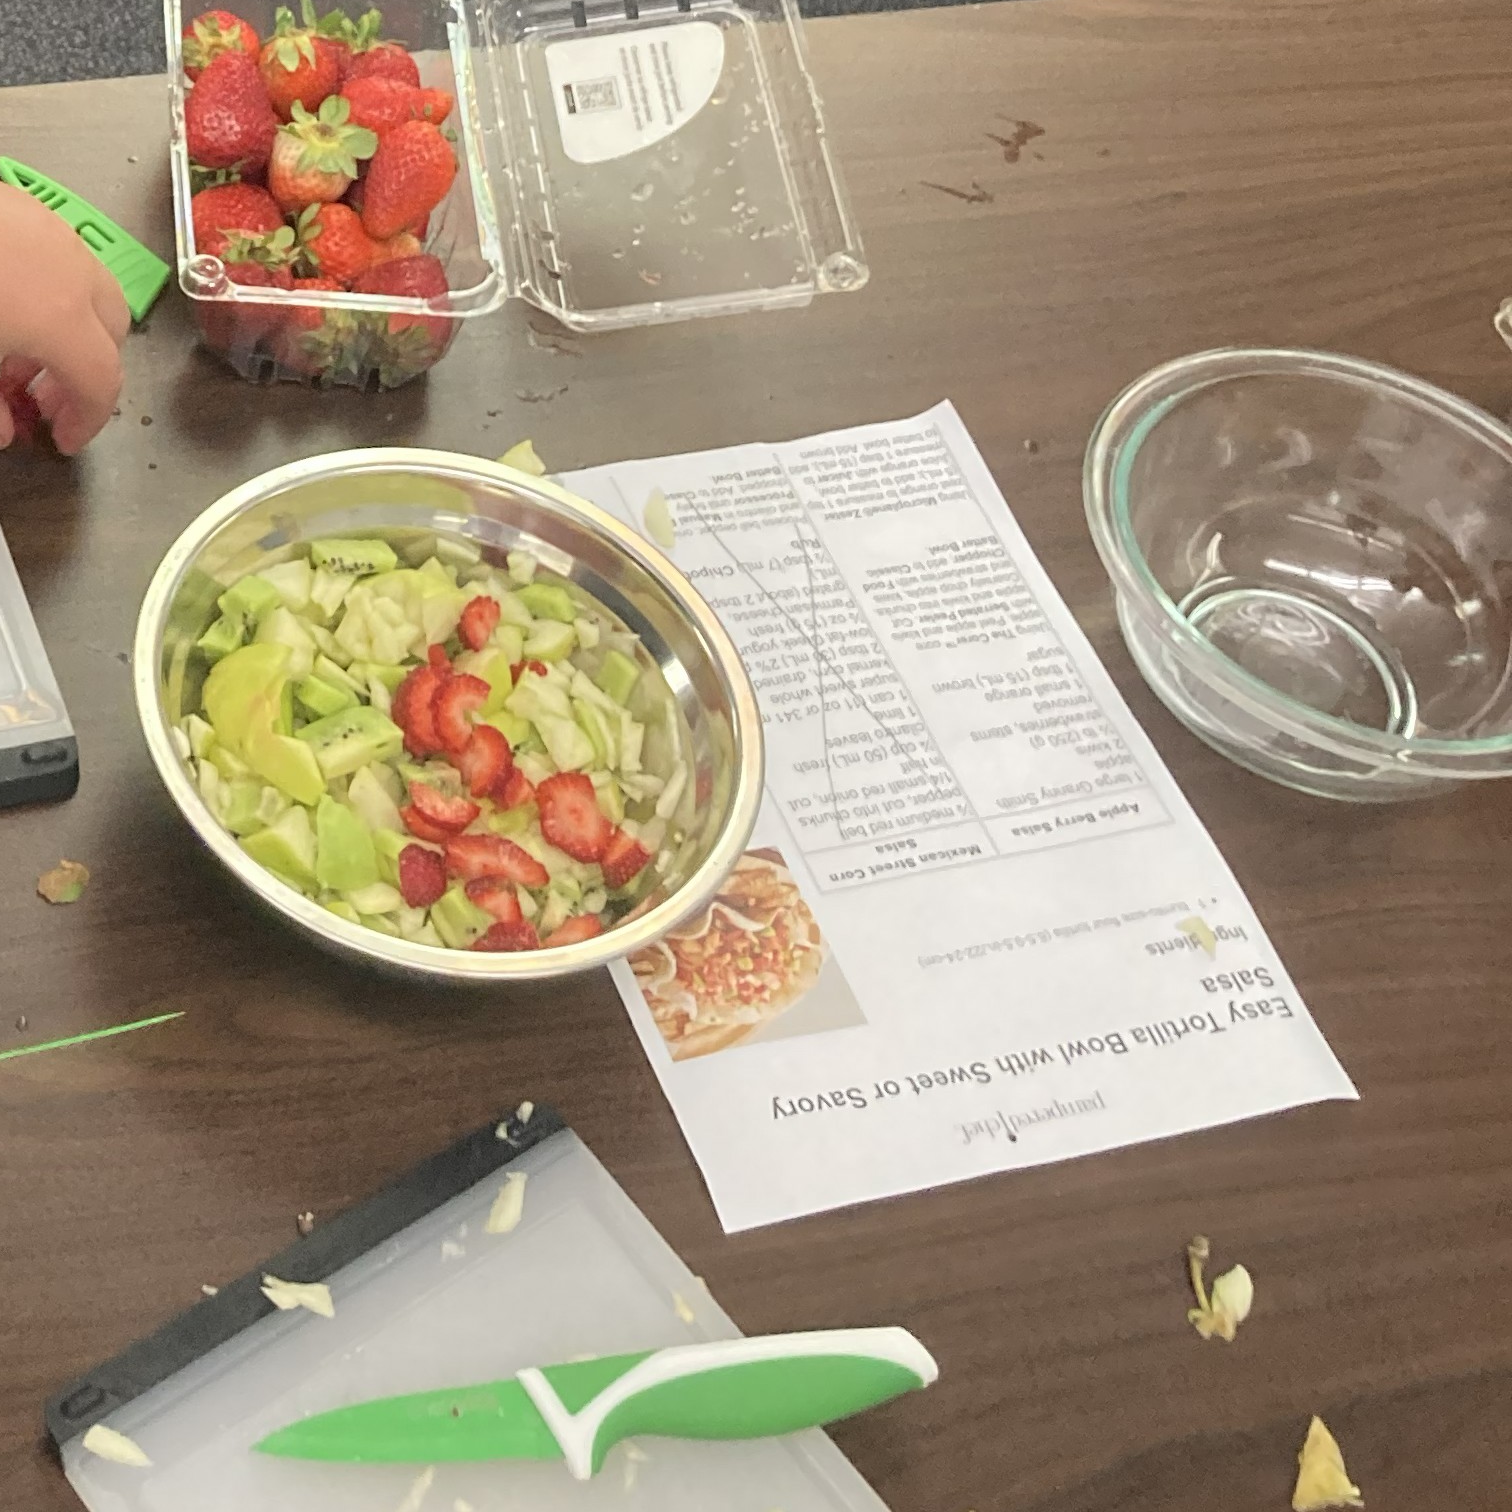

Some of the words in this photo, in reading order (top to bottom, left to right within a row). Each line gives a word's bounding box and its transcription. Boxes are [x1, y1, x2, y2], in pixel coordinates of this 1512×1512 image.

[790, 537, 823, 551] Rub
[727, 605, 781, 622] cheese,
[785, 597, 856, 618] Parmesan
[780, 632, 824, 650] Greek
[825, 625, 873, 643] low-fat
[739, 638, 778, 656] yogur
[812, 647, 836, 663] (30
[838, 643, 869, 656] tbsp
[780, 652, 809, 668] mL)
[846, 658, 891, 674] kernel
[808, 664, 844, 678] corn,
[752, 671, 806, 691] drained
[814, 679, 856, 697] sweet
[860, 672, 899, 688] super
[1033, 679, 1071, 696] small
[769, 688, 812, 704] whole
[868, 691, 894, 703] can
[984, 686, 1032, 702] orange
[844, 695, 867, 710] (11
[775, 708, 802, 723] 341
[871, 707, 905, 723] lime
[874, 722, 927, 739] cilantro
[823, 731, 872, 749] leaves
[890, 740, 916, 755] cup
[831, 752, 860, 768] mL)
[863, 744, 887, 762] (50
[792, 758, 830, 774] fresh
[887, 775, 926, 794] small
[928, 771, 952, 785] 1/4
[1094, 772, 1132, 787] large
[812, 788, 858, 805] onion,
[861, 784, 885, 799] red
[907, 784, 963, 805] pepper,
[1040, 780, 1093, 798] Granny
[786, 797, 811, 811] cut
[881, 798, 905, 813] cut
[995, 792, 1039, 809] Smith
[797, 809, 849, 827] chunks
[852, 803, 880, 817] into
[895, 807, 954, 826] medium
[1098, 802, 1139, 818] Apple
[868, 819, 894, 835] red
[1055, 812, 1096, 827] Berry
[838, 825, 867, 840] bell
[1011, 822, 1052, 835] Salsa
[874, 838, 917, 853] Salsa
[918, 844, 981, 862] Mexican
[868, 857, 916, 875] Street
[828, 868, 865, 881] Corn
[1200, 966, 1274, 992] Salsa
[1228, 996, 1293, 1022] Easy
[1130, 1012, 1225, 1045] Tortilla
[1057, 1032, 1128, 1065] Bowl
[995, 1048, 1053, 1075] with
[905, 1062, 991, 1094] Sweet
[873, 1080, 900, 1099] or
[772, 1087, 866, 1119] Savory
[1009, 1091, 1105, 1132] pampered
